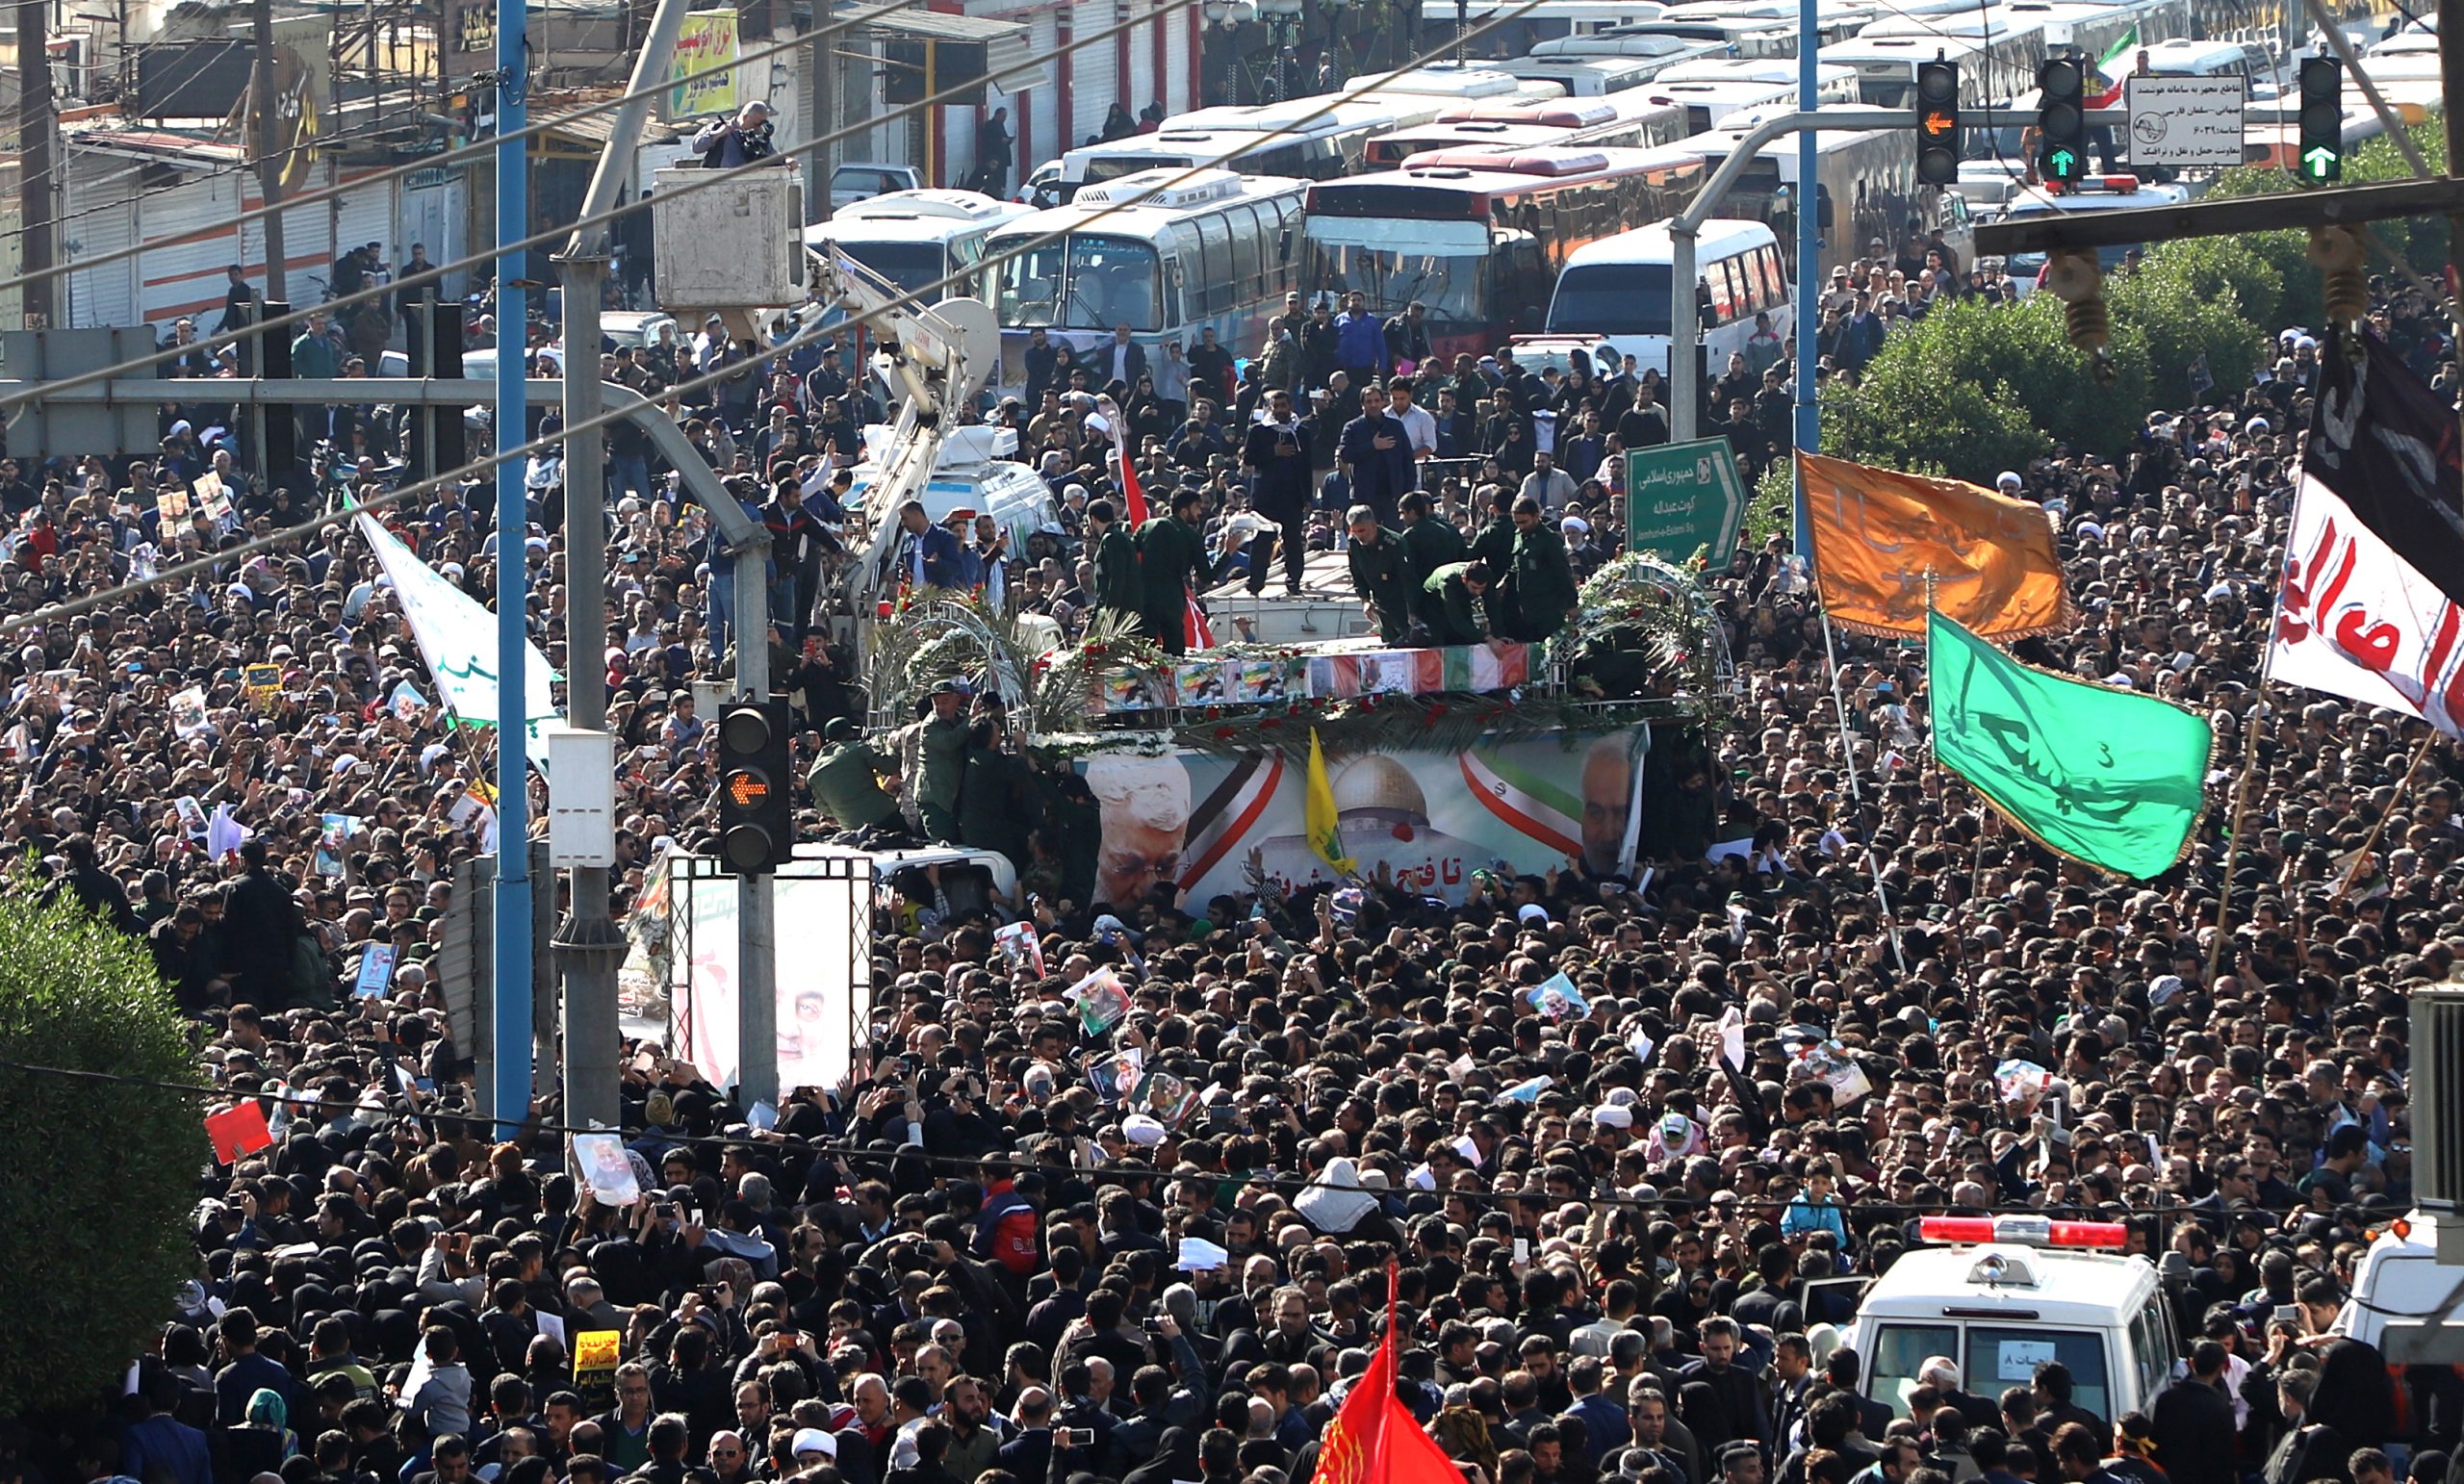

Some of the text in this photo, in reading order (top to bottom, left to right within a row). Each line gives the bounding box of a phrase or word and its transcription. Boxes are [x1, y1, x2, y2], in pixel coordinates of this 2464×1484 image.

[2137, 85, 2165, 95] هوشمند
[2167, 85, 2189, 93] سامانه
[2200, 85, 2218, 95] مجهز
[2220, 84, 2241, 95] تقاطع
[2162, 107, 2185, 117] فارسی
[2142, 146, 2168, 158] ترافیک
[2175, 146, 2188, 157] نقل
[2195, 146, 2213, 156] حمل
[2215, 146, 2241, 156] معاونت
[1638, 467, 1694, 490] جمهوری اسلامی
[1442, 856, 1462, 886] تا
